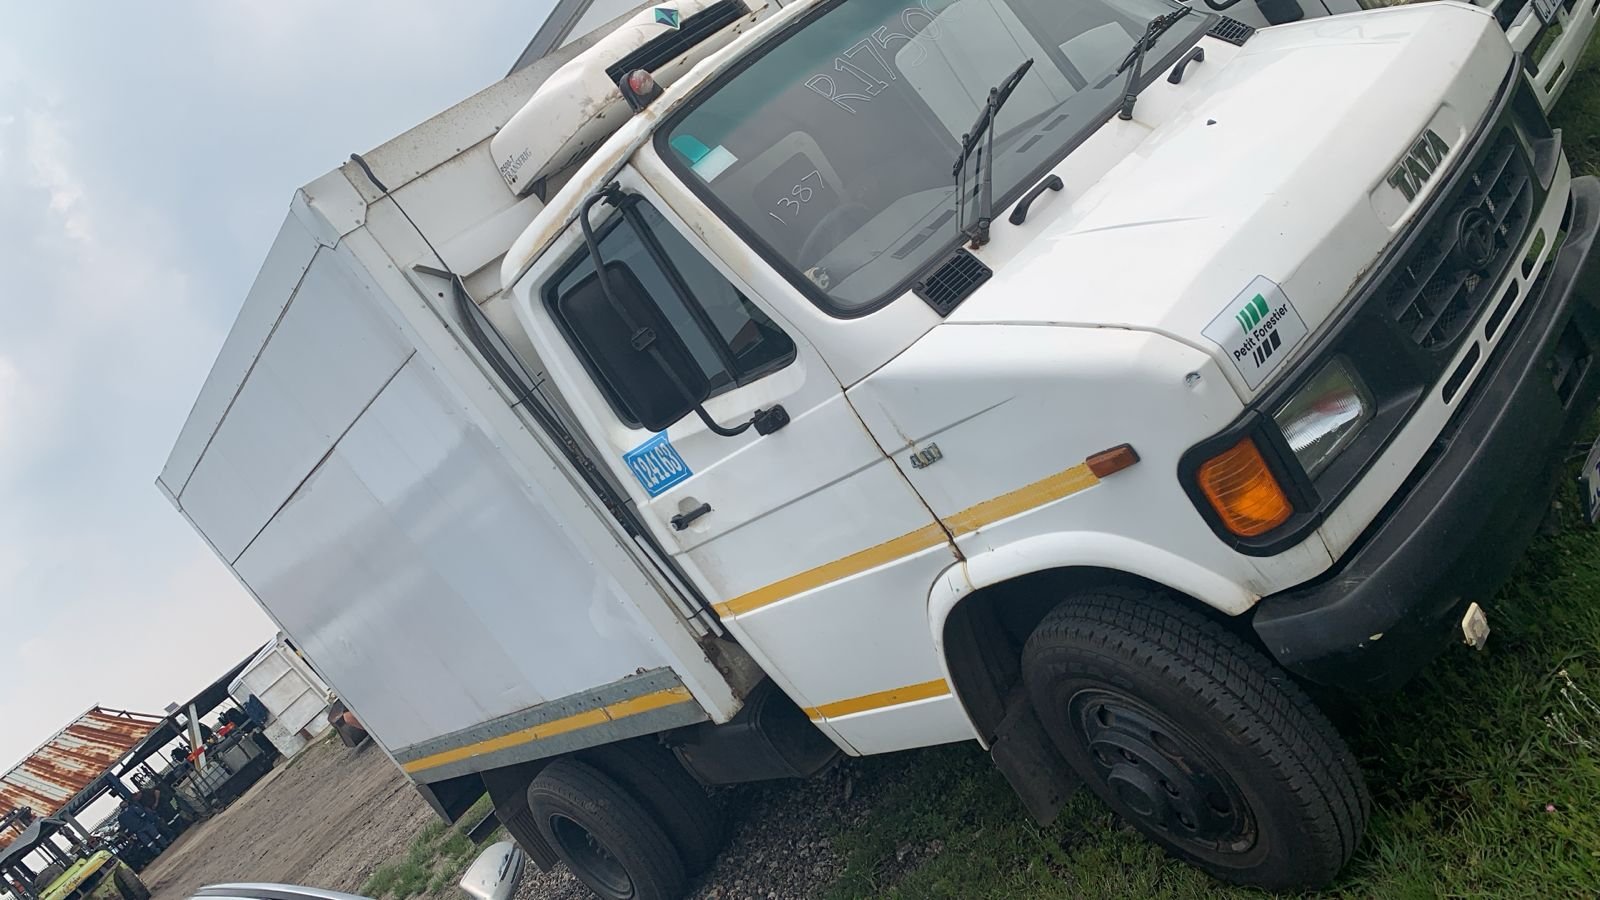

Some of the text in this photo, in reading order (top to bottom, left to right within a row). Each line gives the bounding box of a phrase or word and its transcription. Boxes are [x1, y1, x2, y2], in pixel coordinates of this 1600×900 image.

[1387, 128, 1450, 204] TATA
[768, 169, 825, 226] 1387
[1233, 303, 1289, 362] Petit Forestier
[632, 442, 683, 488] 124163
